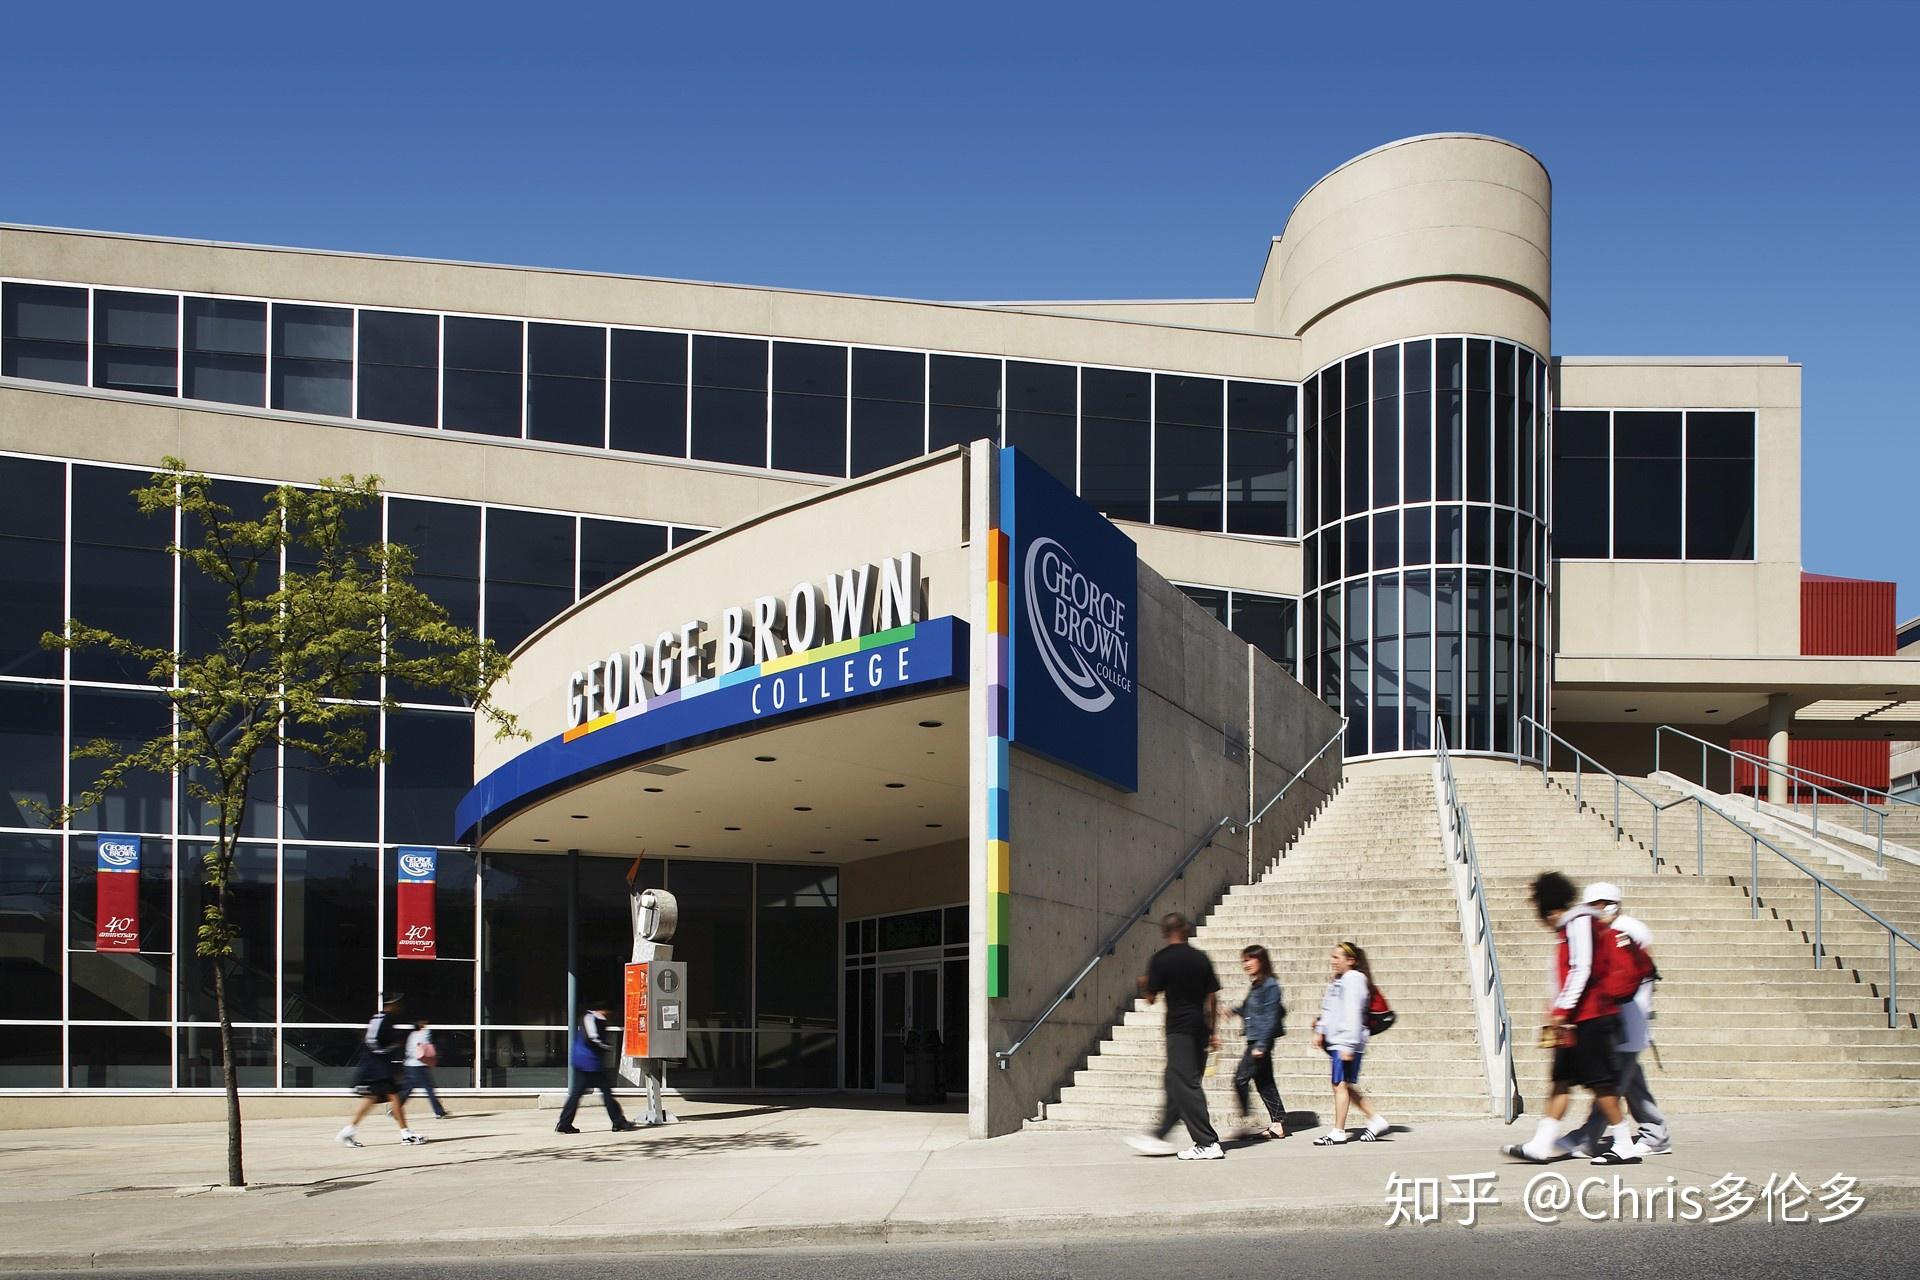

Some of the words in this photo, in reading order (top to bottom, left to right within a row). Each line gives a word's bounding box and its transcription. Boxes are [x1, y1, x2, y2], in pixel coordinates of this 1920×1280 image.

[1042, 551, 1126, 637] GEORGE
[566, 620, 706, 728] GEORGE
[723, 551, 921, 673] BROWN
[1054, 596, 1129, 675] BROWN
[751, 646, 909, 714] COLLEGE
[1096, 662, 1132, 693] COLLEGE
[105, 843, 135, 852] GEORGE
[99, 931, 138, 941] anniversary
